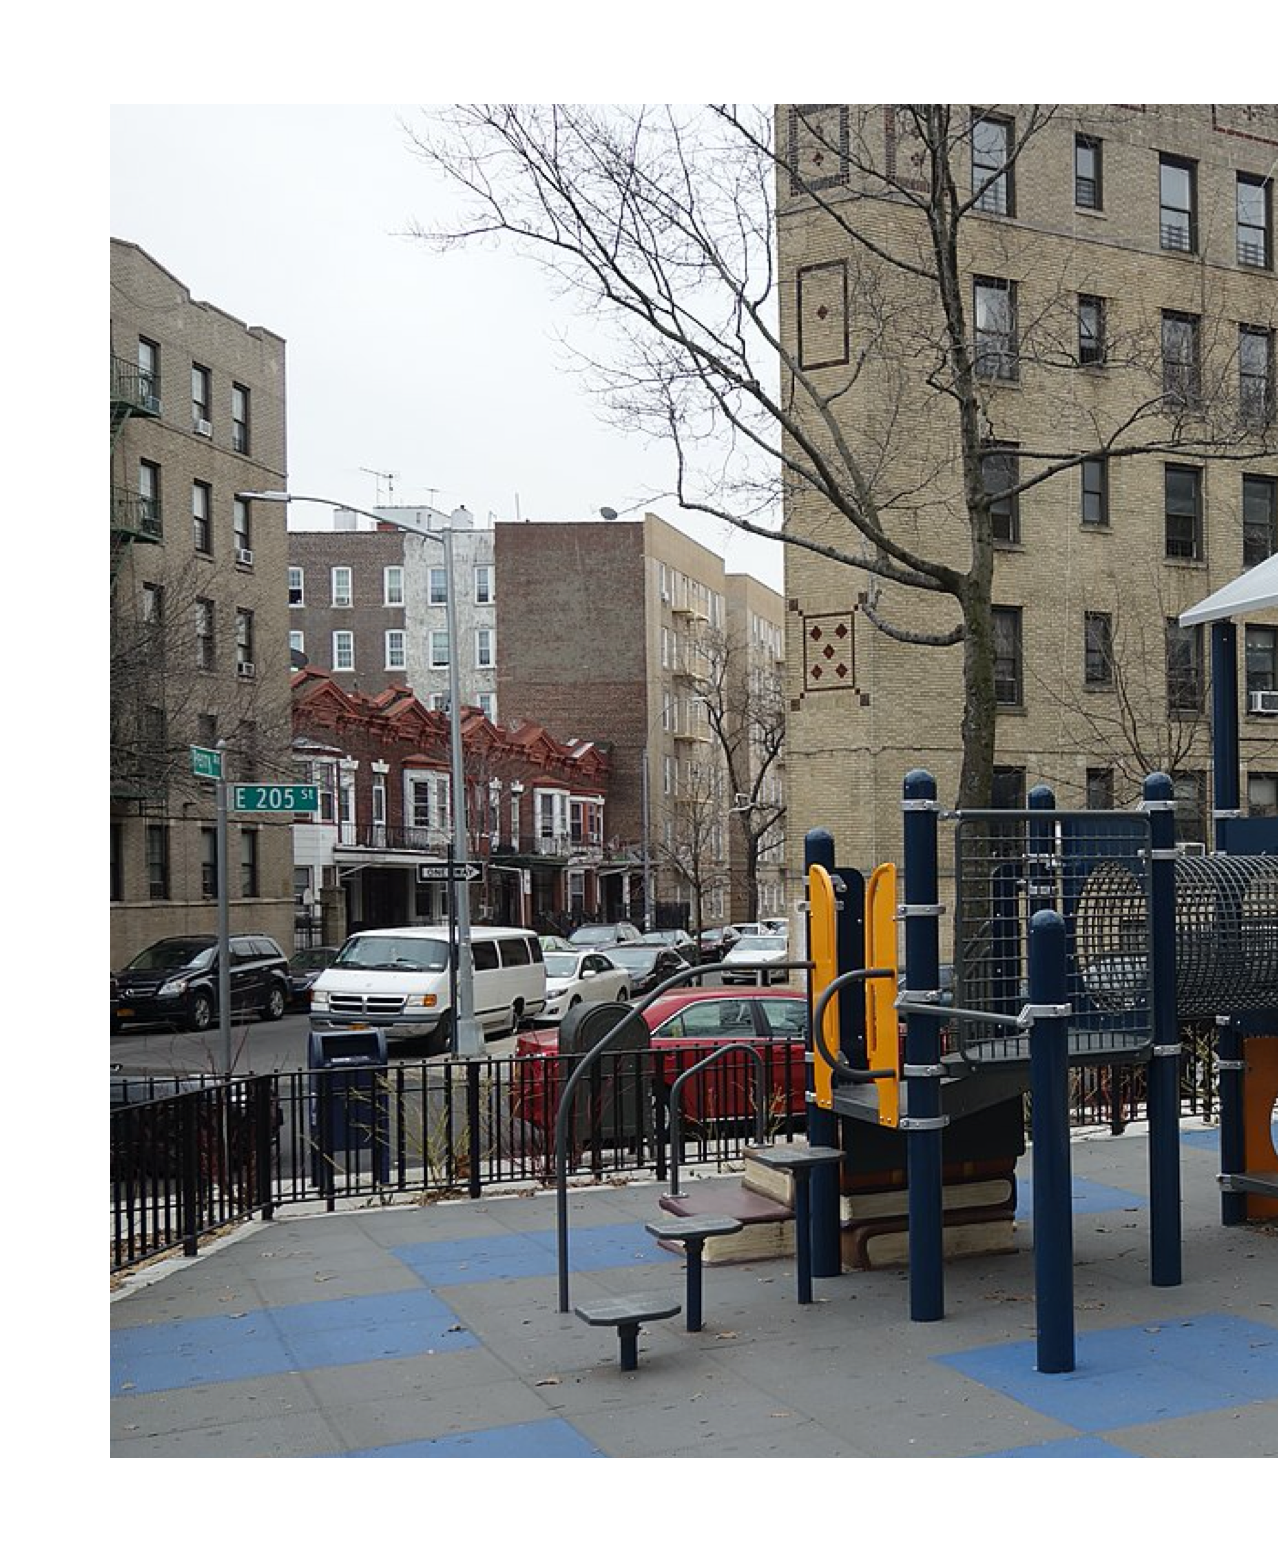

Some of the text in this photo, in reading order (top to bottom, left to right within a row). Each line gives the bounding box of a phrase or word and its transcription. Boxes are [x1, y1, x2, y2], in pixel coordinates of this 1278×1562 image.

[236, 788, 313, 808] E 205 St
[427, 868, 446, 877] ONE
